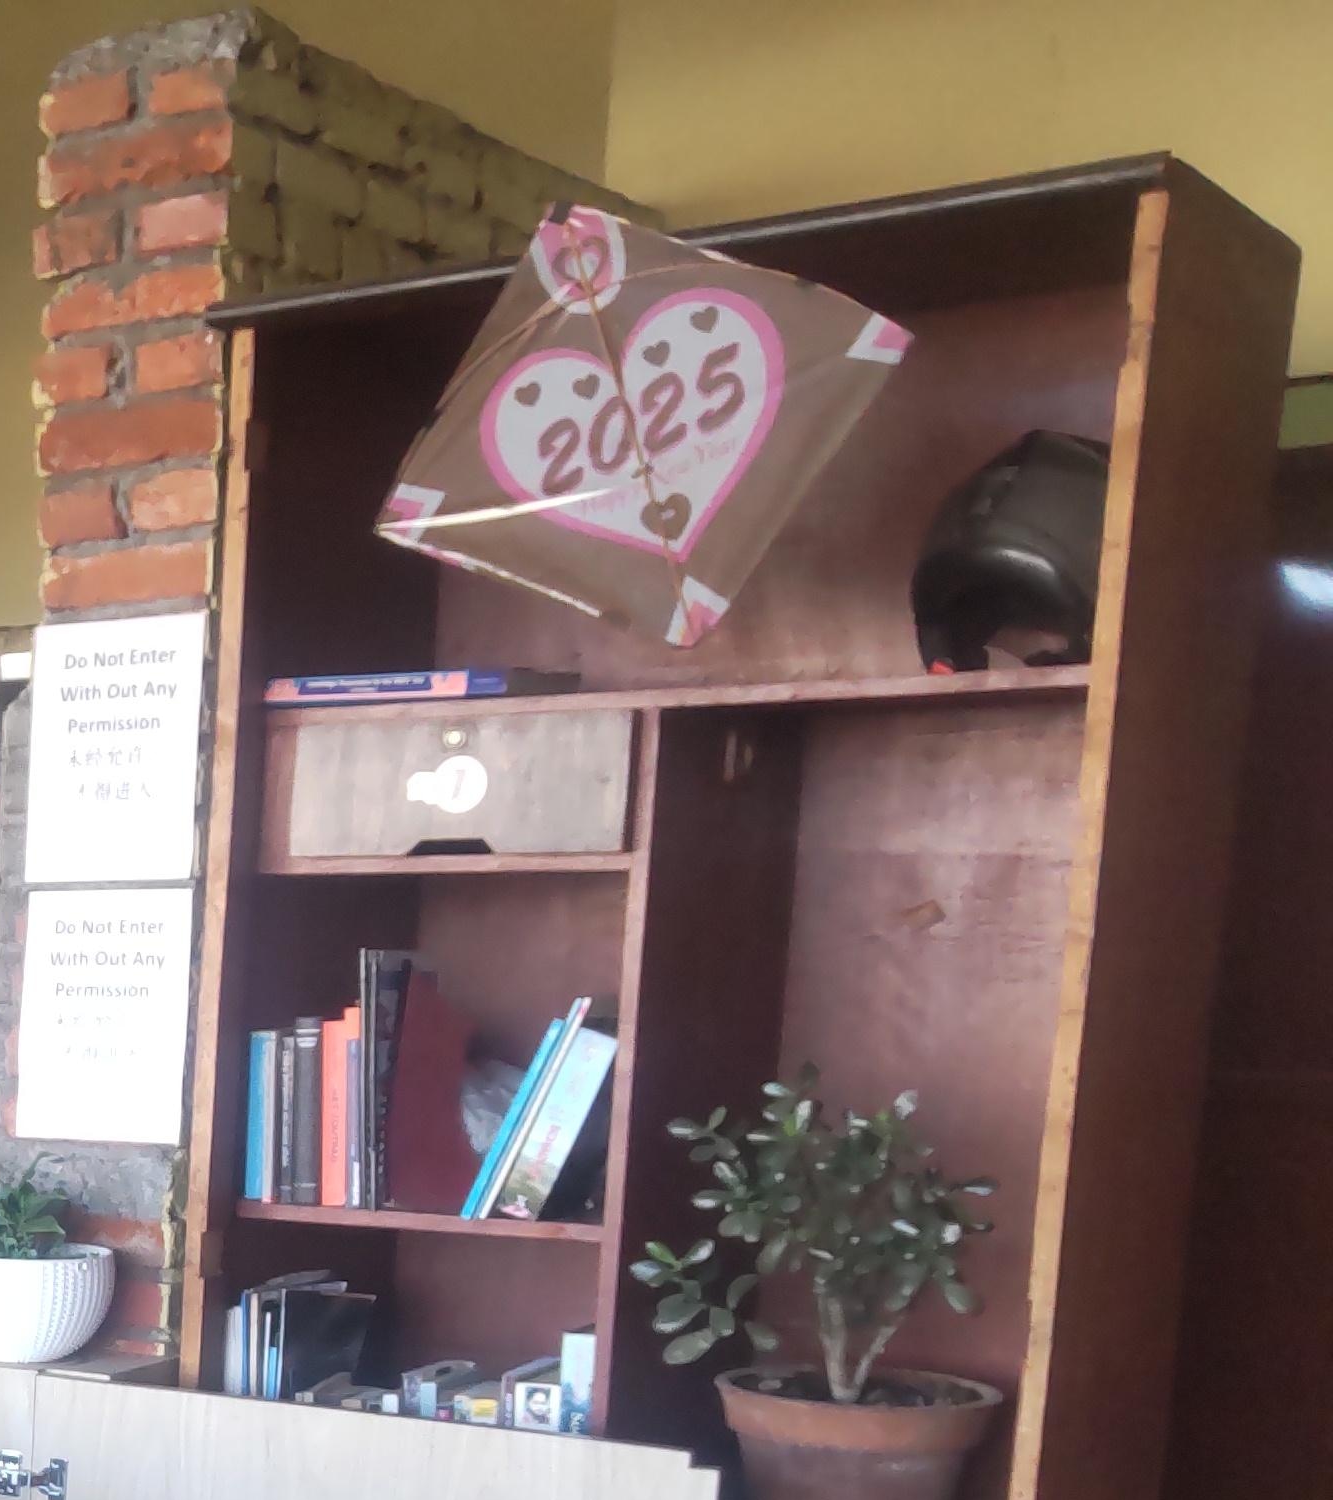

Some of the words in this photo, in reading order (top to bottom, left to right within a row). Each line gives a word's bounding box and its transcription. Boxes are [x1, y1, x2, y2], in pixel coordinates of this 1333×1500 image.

[538, 342, 746, 496] 2025
[64, 653, 88, 669] Do
[94, 651, 124, 668] Not
[130, 648, 177, 666] Enter
[61, 684, 101, 702] With
[107, 683, 137, 699] Out
[143, 681, 178, 699] Any
[68, 715, 161, 734] Permission
[55, 919, 76, 935] Do
[82, 919, 112, 935] Not
[119, 919, 165, 934] Enter
[50, 951, 89, 967] With
[95, 951, 126, 966] Out
[132, 951, 166, 969] Any
[55, 983, 149, 998] Permission
